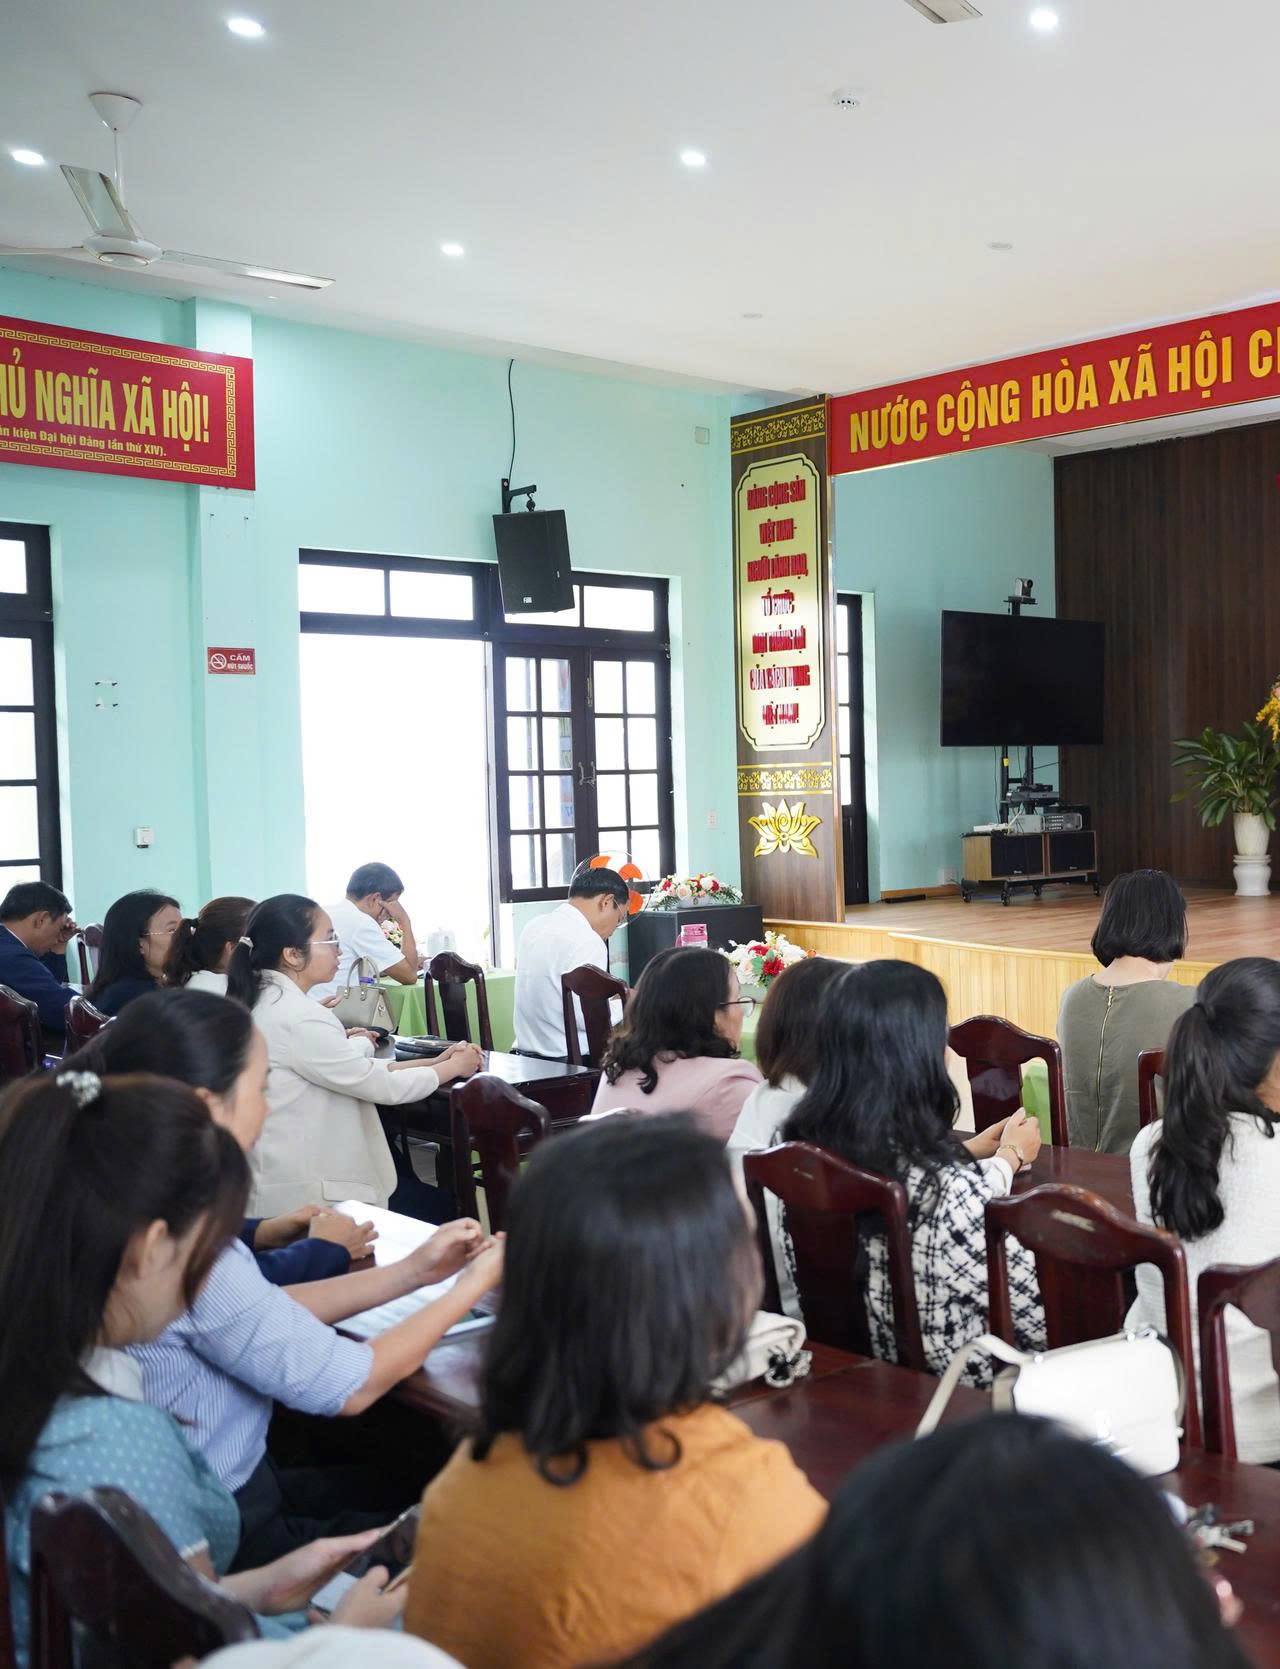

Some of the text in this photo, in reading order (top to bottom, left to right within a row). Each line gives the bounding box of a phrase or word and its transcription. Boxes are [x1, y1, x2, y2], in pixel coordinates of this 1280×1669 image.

[35, 367, 116, 431] NGHĨA
[122, 375, 156, 436] XÃ
[162, 381, 209, 452] HỘI!
[850, 394, 928, 453] NƯỚC
[937, 380, 1020, 441] CỘNG
[1032, 359, 1099, 418] HÒA
[1109, 342, 1157, 404] XÃ
[1168, 330, 1232, 398] HỘI
[13, 427, 37, 441] kiện
[40, 430, 57, 443] Đại
[60, 432, 76, 447] hội
[79, 435, 105, 449] Đảng
[108, 438, 124, 451] lần
